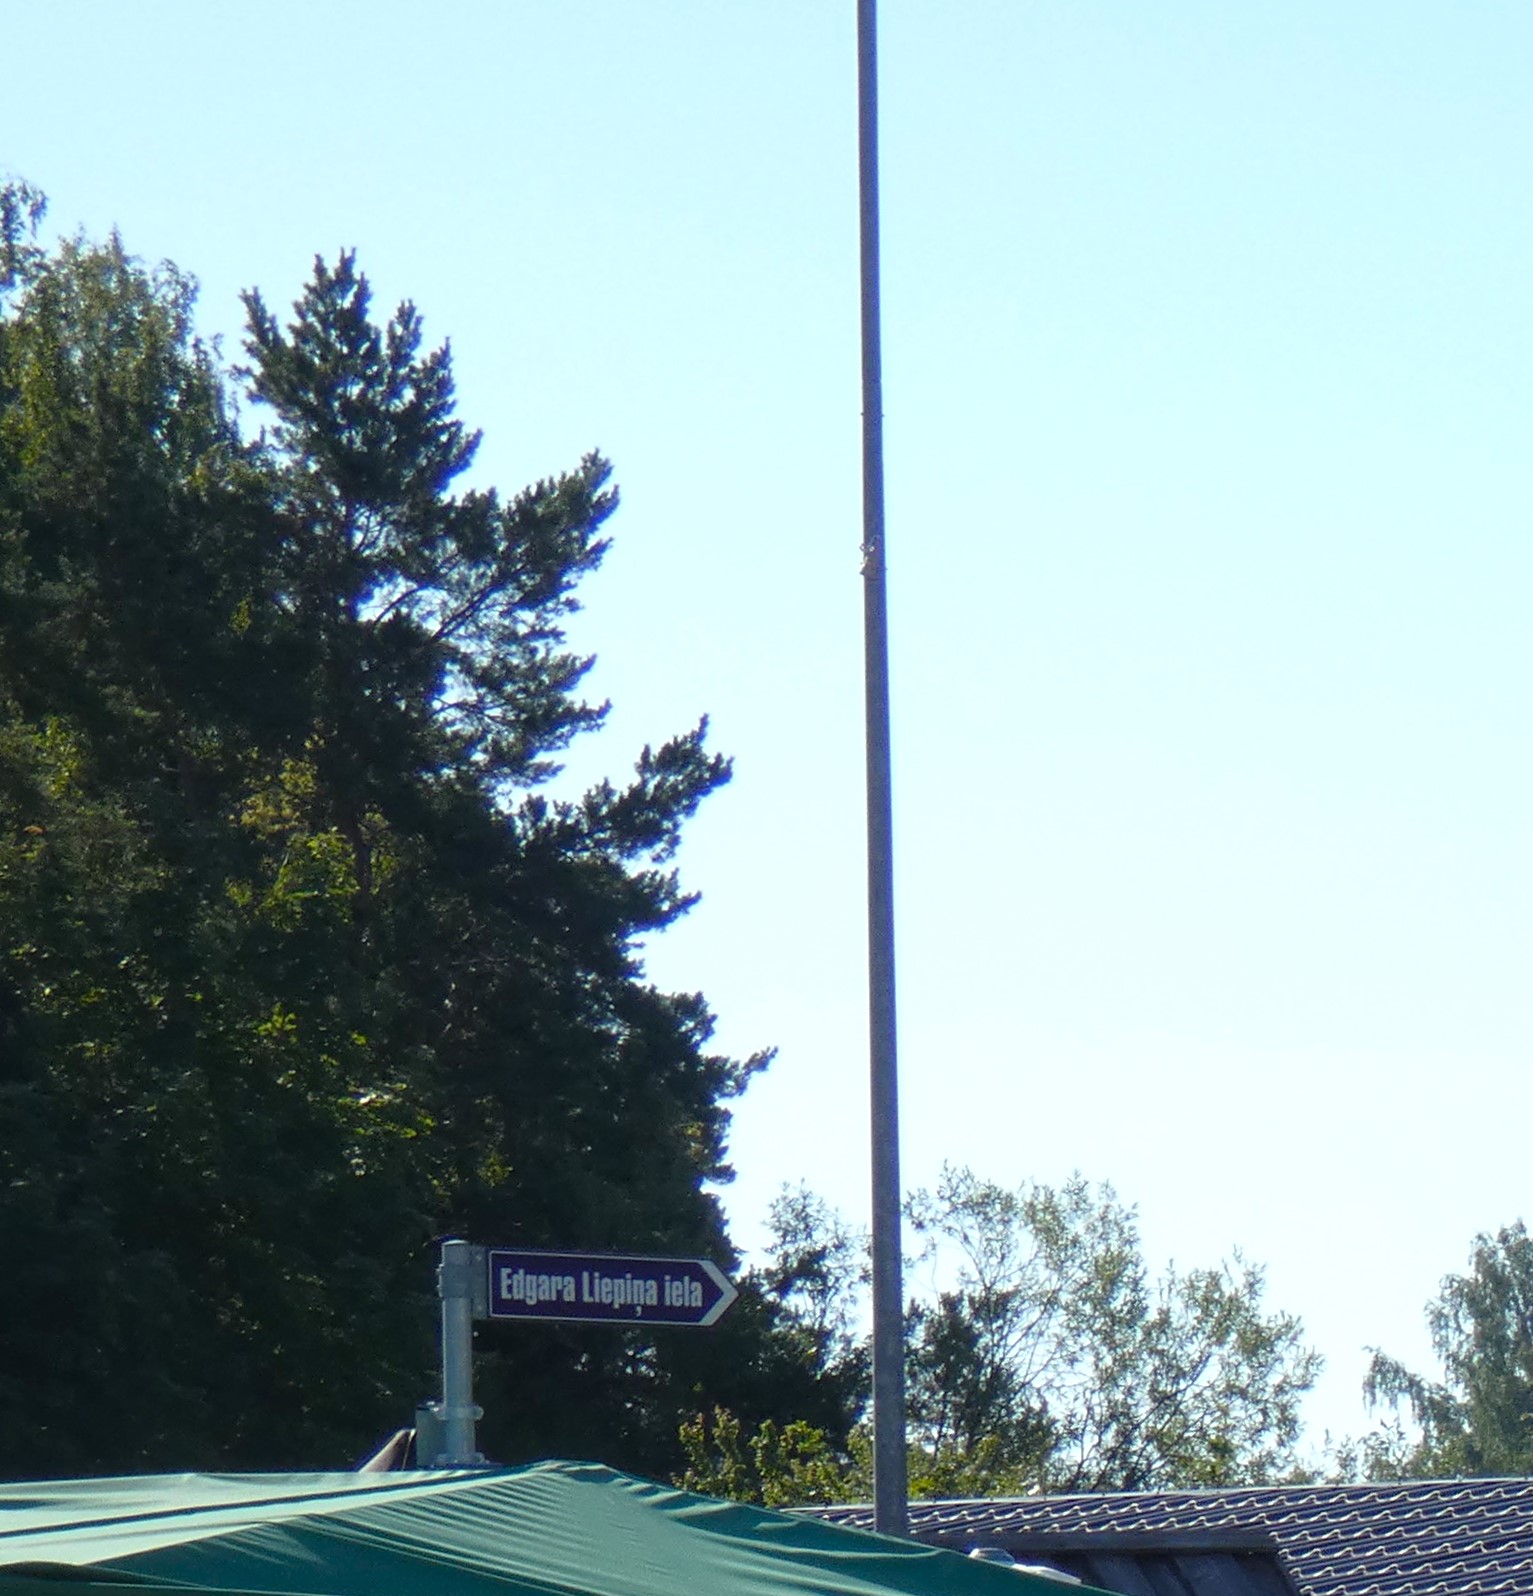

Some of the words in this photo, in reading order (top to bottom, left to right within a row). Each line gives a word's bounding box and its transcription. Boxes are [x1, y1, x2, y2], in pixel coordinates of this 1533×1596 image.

[500, 1267, 576, 1305] Edgara
[582, 1271, 658, 1317] Liepiņa
[664, 1275, 703, 1307] iela
